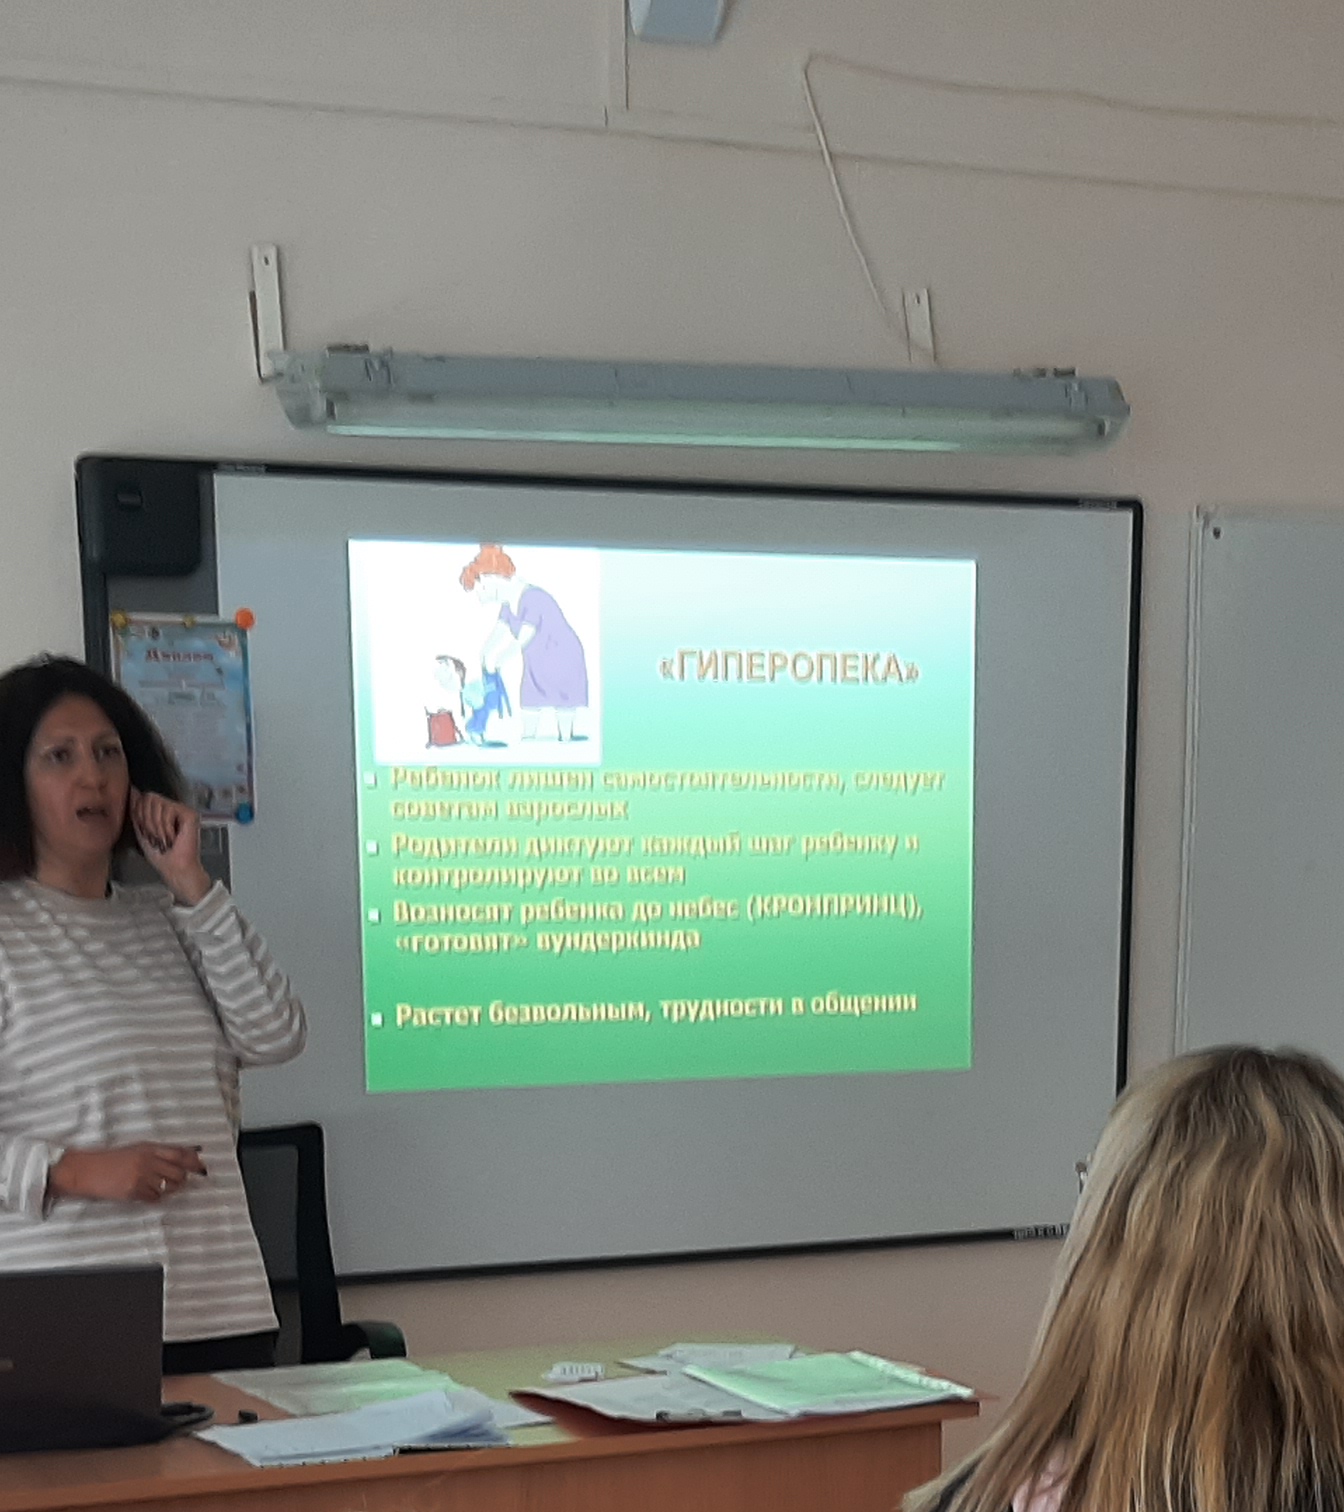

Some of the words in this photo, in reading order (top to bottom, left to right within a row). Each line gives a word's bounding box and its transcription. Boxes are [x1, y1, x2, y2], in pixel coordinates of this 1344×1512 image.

[659, 649, 920, 684] «ГИПЕРОПЕКА»
[391, 766, 500, 790] Ребенок
[508, 771, 593, 790] лишен
[855, 771, 945, 795] следует
[391, 800, 498, 820] советам
[508, 800, 629, 825] взрослых
[392, 833, 519, 859] Родители
[525, 836, 633, 859] диктуют
[642, 831, 740, 858] каждый
[749, 835, 796, 856] шаг
[802, 831, 897, 861] ребенку
[906, 835, 919, 854] и
[394, 866, 582, 892] контролируют
[591, 866, 620, 886] во
[627, 866, 686, 886] всем
[394, 899, 512, 925] Возносят
[521, 897, 624, 928] ребенка
[633, 902, 662, 922] до
[670, 896, 739, 920] небес
[747, 893, 923, 923] (КРОНПРИНЦ),
[396, 932, 529, 954] «готовит»
[537, 930, 701, 955] вундеркинда
[397, 1003, 482, 1028] Растет
[490, 1000, 651, 1025] безвольным,
[661, 997, 784, 1023] трудности
[791, 997, 804, 1015] в
[811, 990, 917, 1017] общении
